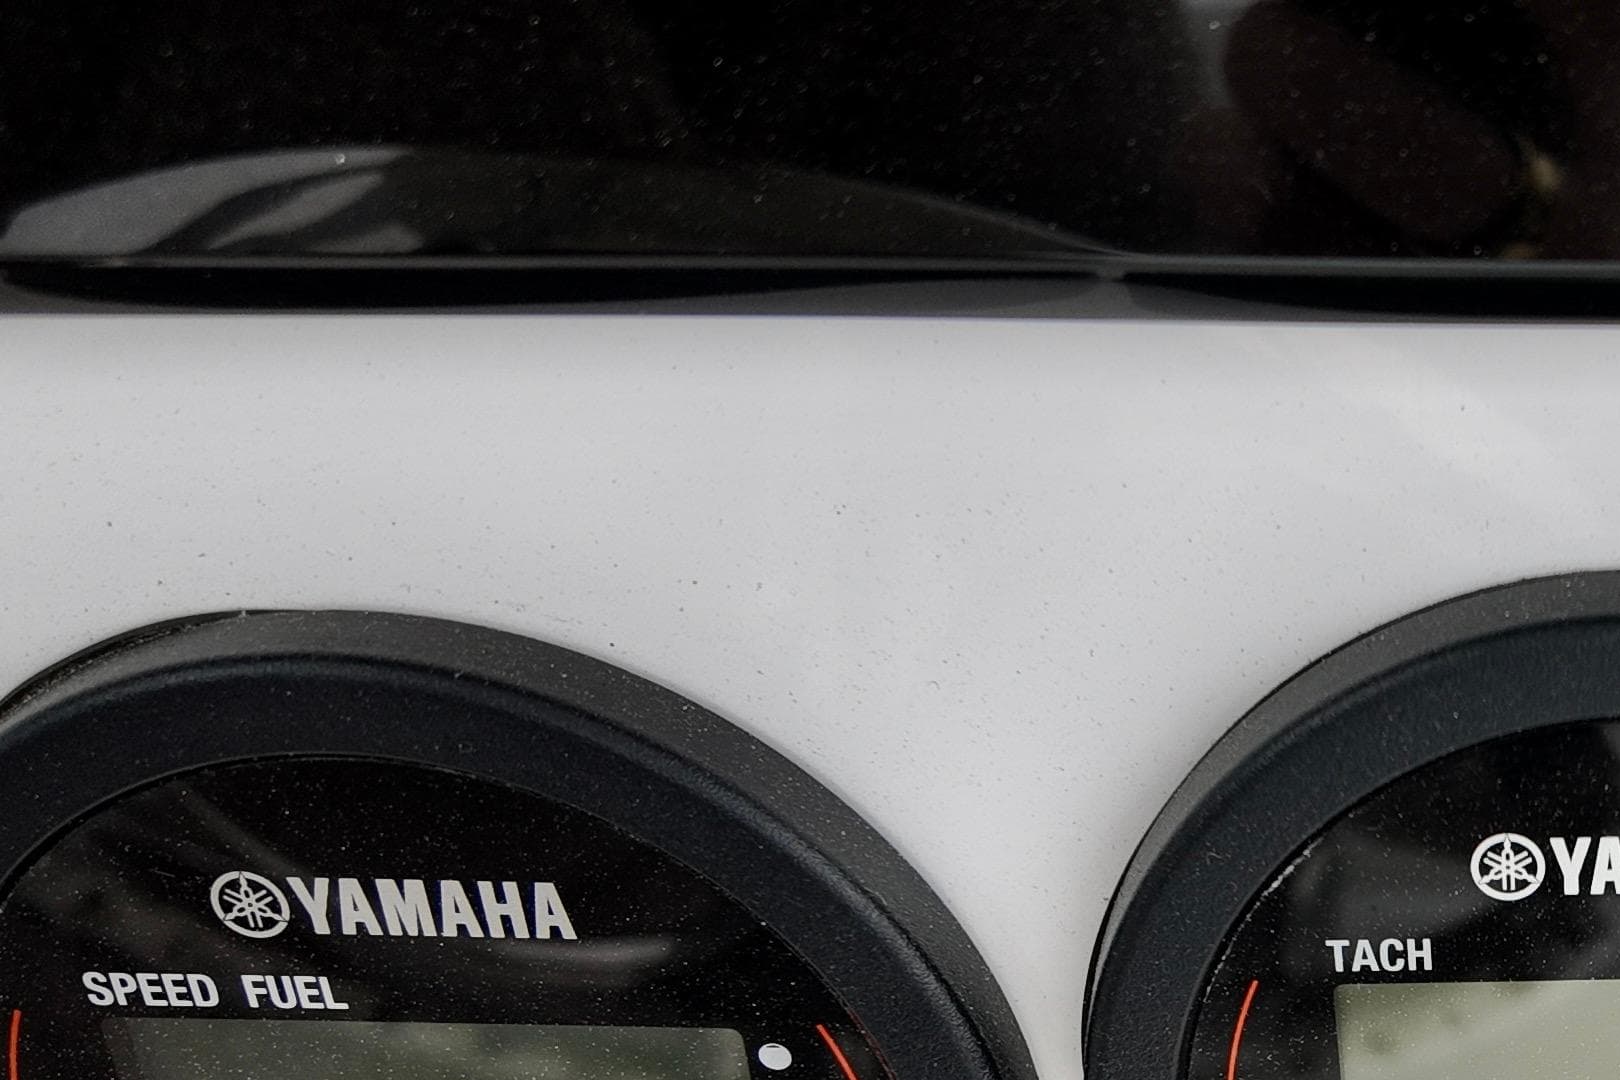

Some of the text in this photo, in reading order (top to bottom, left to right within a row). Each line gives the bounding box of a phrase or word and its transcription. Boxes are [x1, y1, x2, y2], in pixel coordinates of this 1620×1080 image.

[288, 876, 578, 940] YAMAHA
[1325, 938, 1433, 973] TACH
[82, 971, 350, 1011] SPEED FUEL
